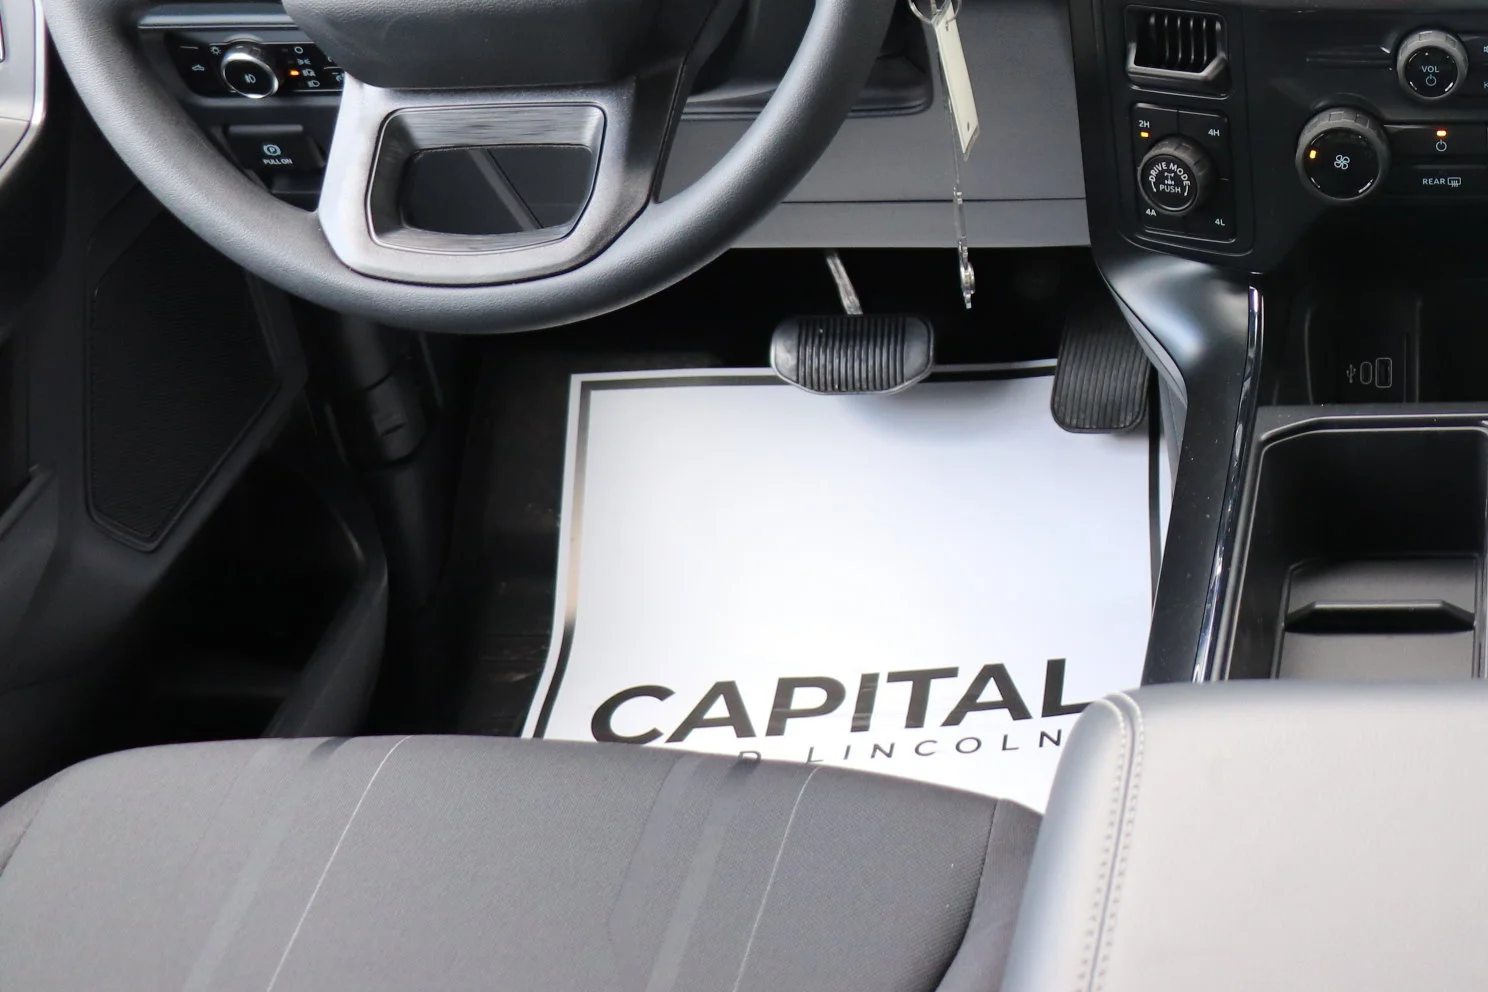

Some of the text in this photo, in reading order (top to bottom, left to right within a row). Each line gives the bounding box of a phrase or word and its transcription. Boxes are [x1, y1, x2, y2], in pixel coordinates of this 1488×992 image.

[1421, 65, 1440, 73] VOL
[1138, 119, 1150, 128] 2H
[1208, 128, 1220, 137] 4H
[1149, 161, 1191, 186] DRIVE MODE
[1422, 177, 1446, 186] REAR
[1159, 184, 1182, 194] PUSH
[1145, 208, 1157, 217] 4A
[1214, 218, 1226, 226] 4L
[591, 658, 1095, 745] CAPITAL
[806, 729, 1062, 765] LINCOLN
